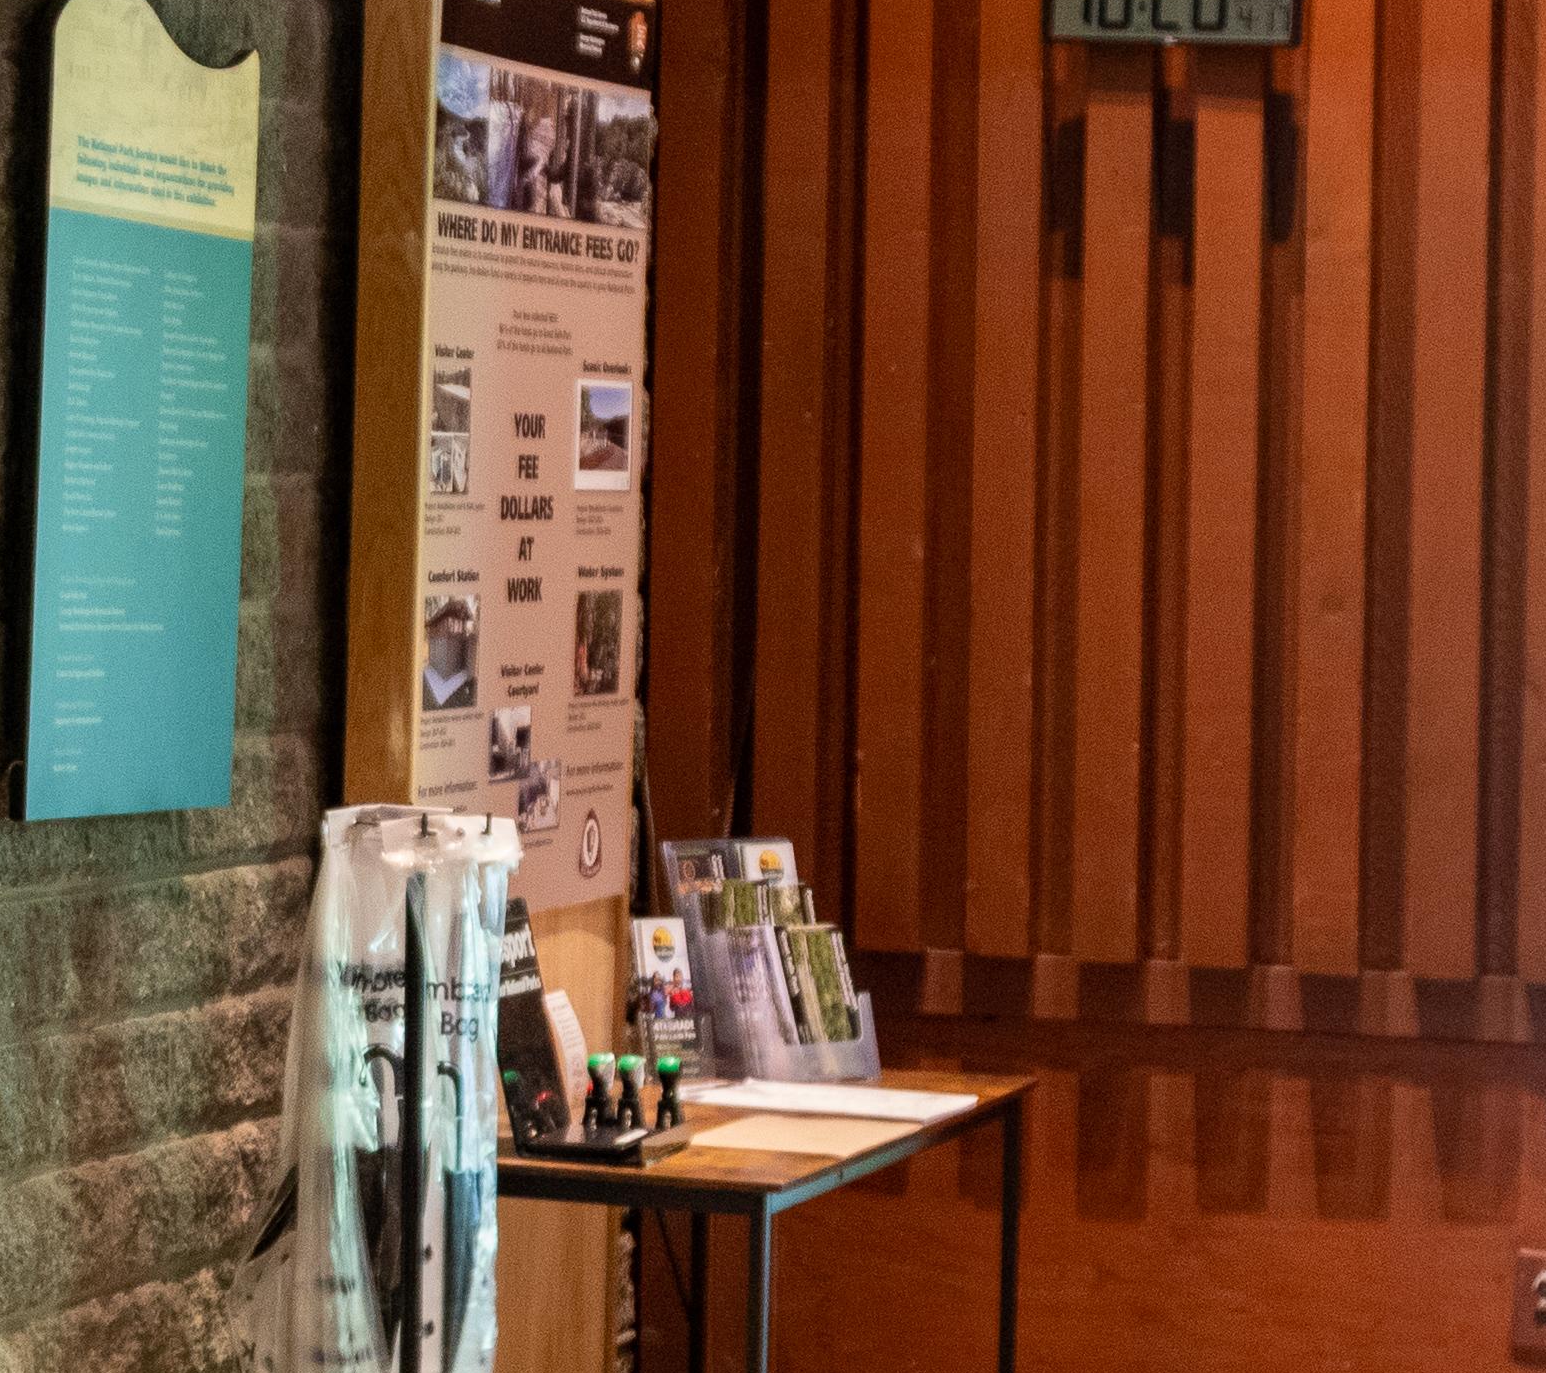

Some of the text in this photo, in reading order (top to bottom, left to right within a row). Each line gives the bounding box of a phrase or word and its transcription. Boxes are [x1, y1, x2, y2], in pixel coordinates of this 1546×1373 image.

[438, 212, 640, 263] WHERE DO MY ENTRANCE FEES GO?
[514, 413, 545, 439] YOUR
[518, 455, 539, 479] FEE
[500, 495, 554, 521] DOLLARS
[518, 536, 534, 561] AT
[507, 577, 542, 603] WORK
[501, 922, 536, 968] sport
[440, 1012, 479, 1041] Bag
